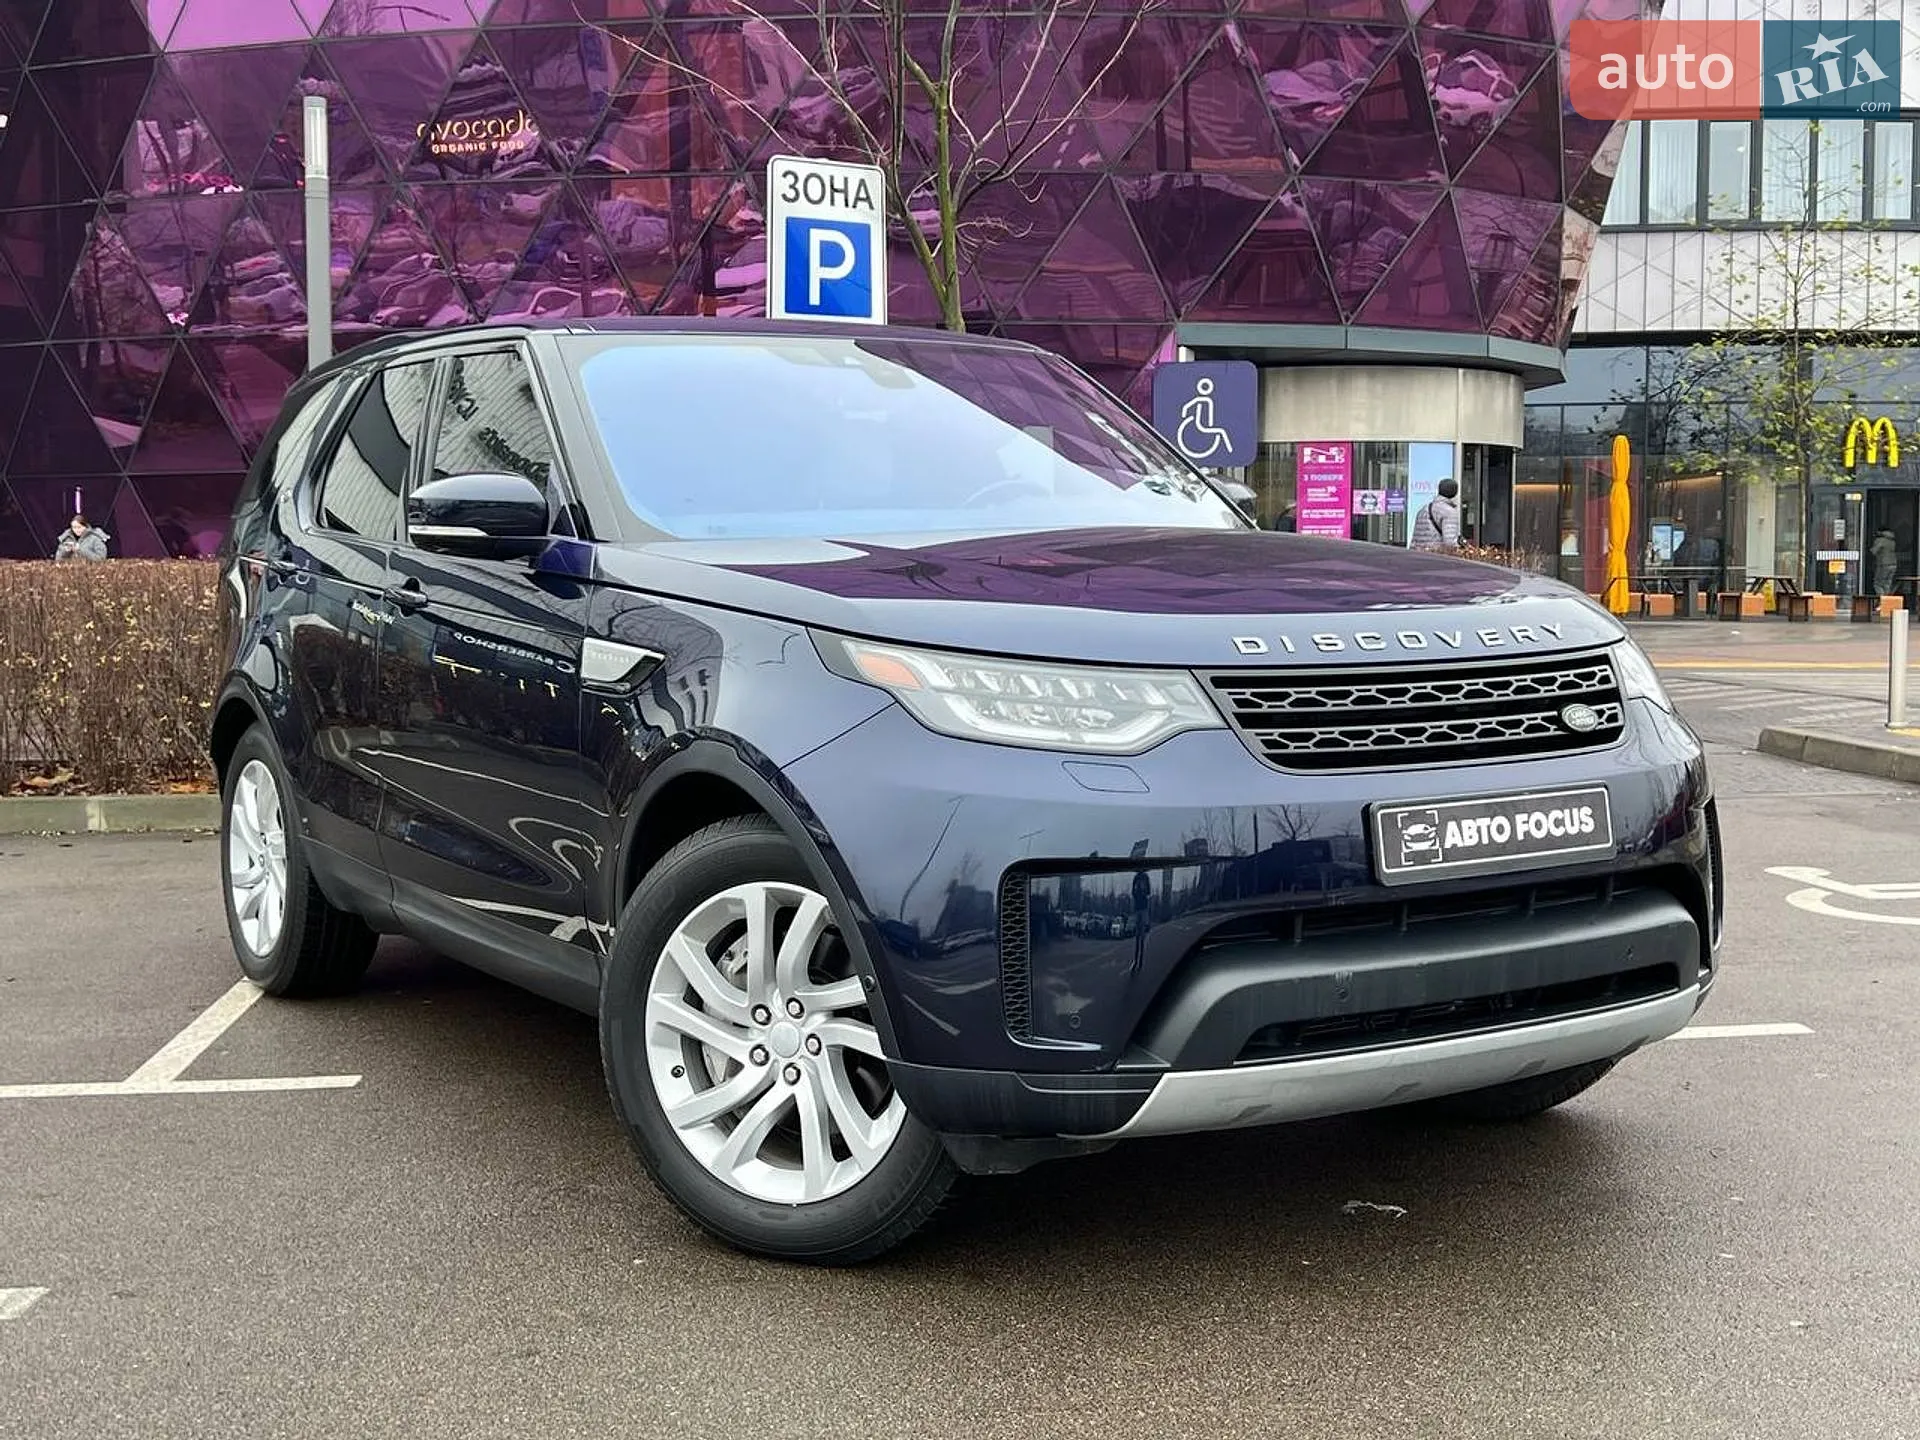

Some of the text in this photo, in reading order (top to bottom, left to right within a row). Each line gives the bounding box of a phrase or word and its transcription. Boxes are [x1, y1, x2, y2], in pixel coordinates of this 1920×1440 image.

[432, 140, 524, 154] ORGANIC FOOD
[780, 169, 875, 212] ЗОНА
[1231, 622, 1567, 656] DISCOVERY
[1443, 805, 1595, 849] АВТО FOCUS
